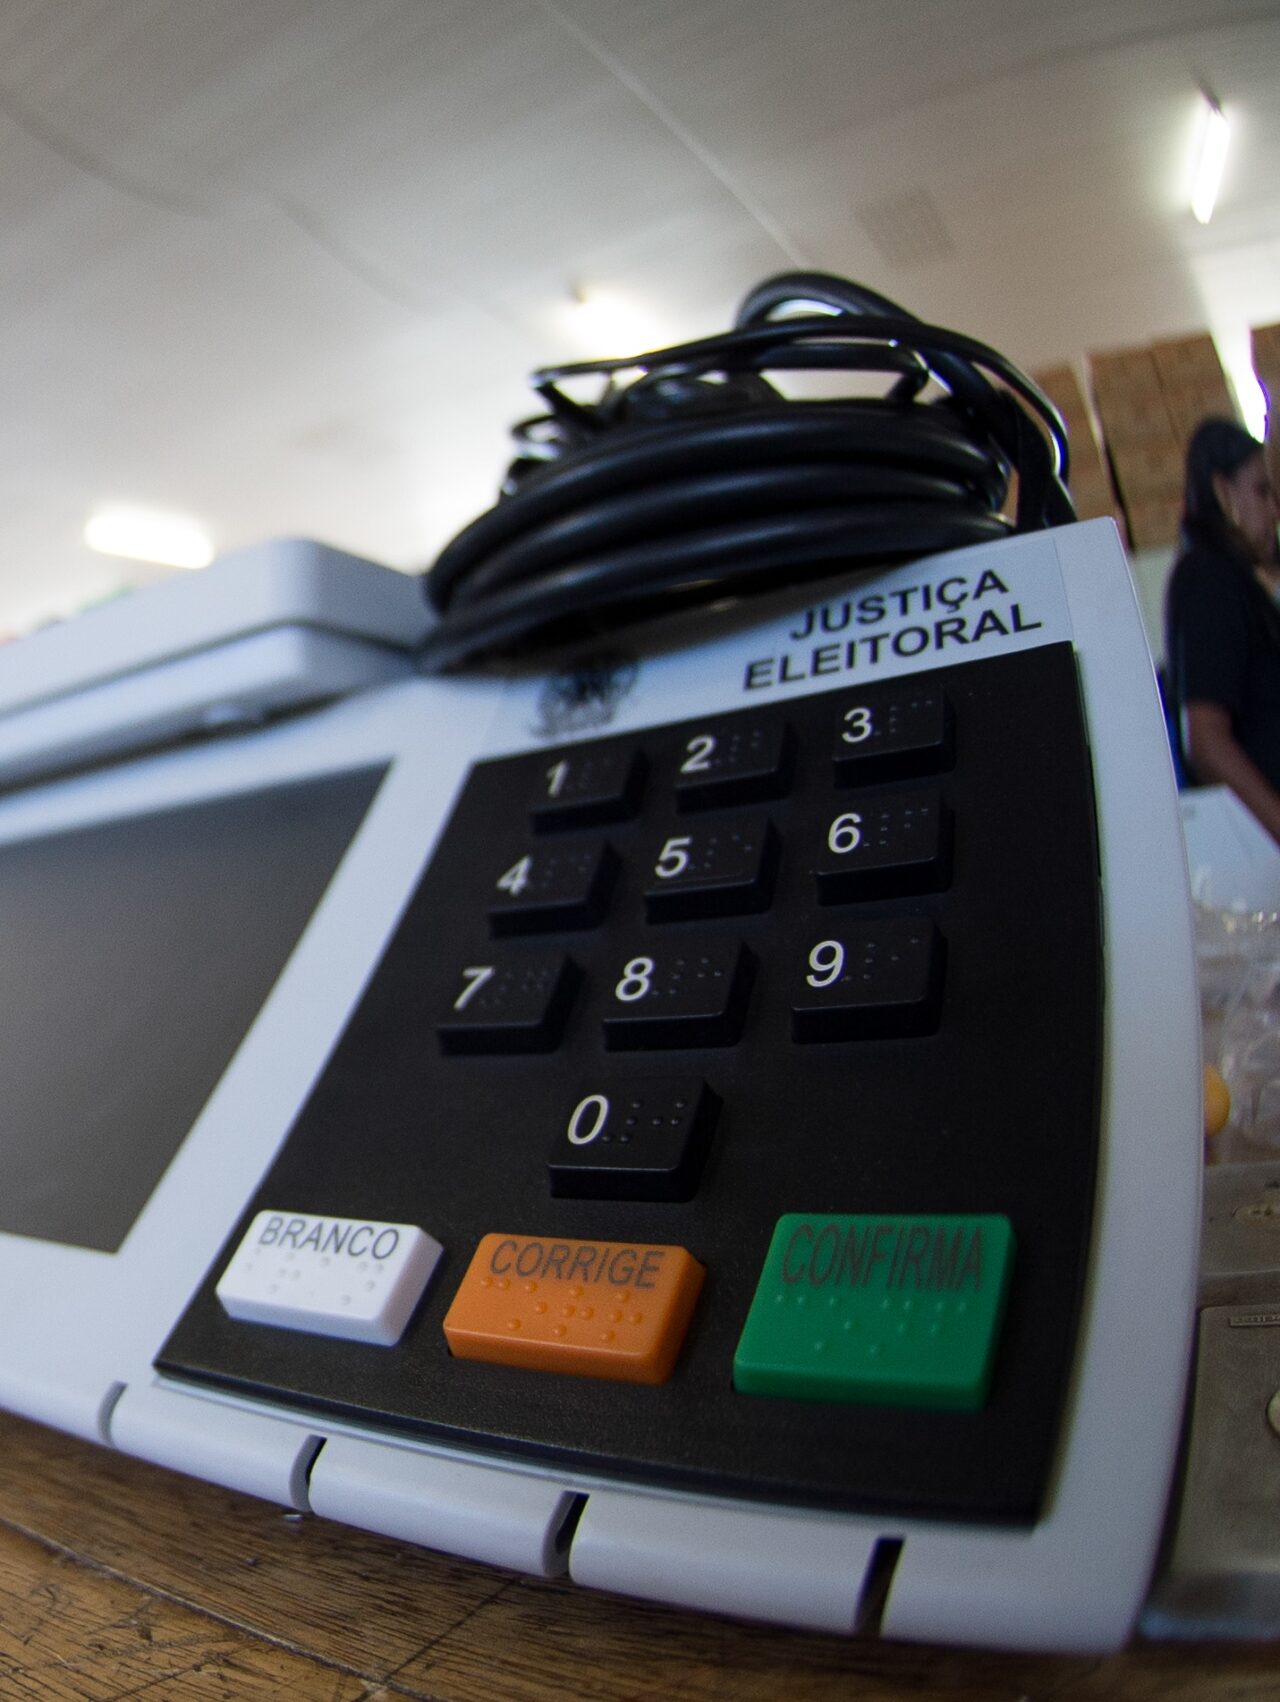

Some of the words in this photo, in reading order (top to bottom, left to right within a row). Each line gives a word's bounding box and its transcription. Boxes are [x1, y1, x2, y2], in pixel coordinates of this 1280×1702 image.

[789, 569, 1010, 642] JUSTIÇA
[743, 603, 1042, 691] ELEITORAL
[842, 707, 872, 743] 3
[680, 735, 715, 773] 2
[545, 761, 568, 797] 1
[828, 812, 862, 854] 6
[497, 856, 531, 895] 4
[654, 836, 691, 878] 5
[615, 956, 654, 1002] 8
[806, 940, 845, 988] 9
[454, 966, 494, 1009] 7
[567, 1094, 609, 1145] 0
[257, 1216, 400, 1260] BRANCO
[781, 1222, 984, 1292] CONFIRMA
[489, 1239, 666, 1289] CORRIGE
